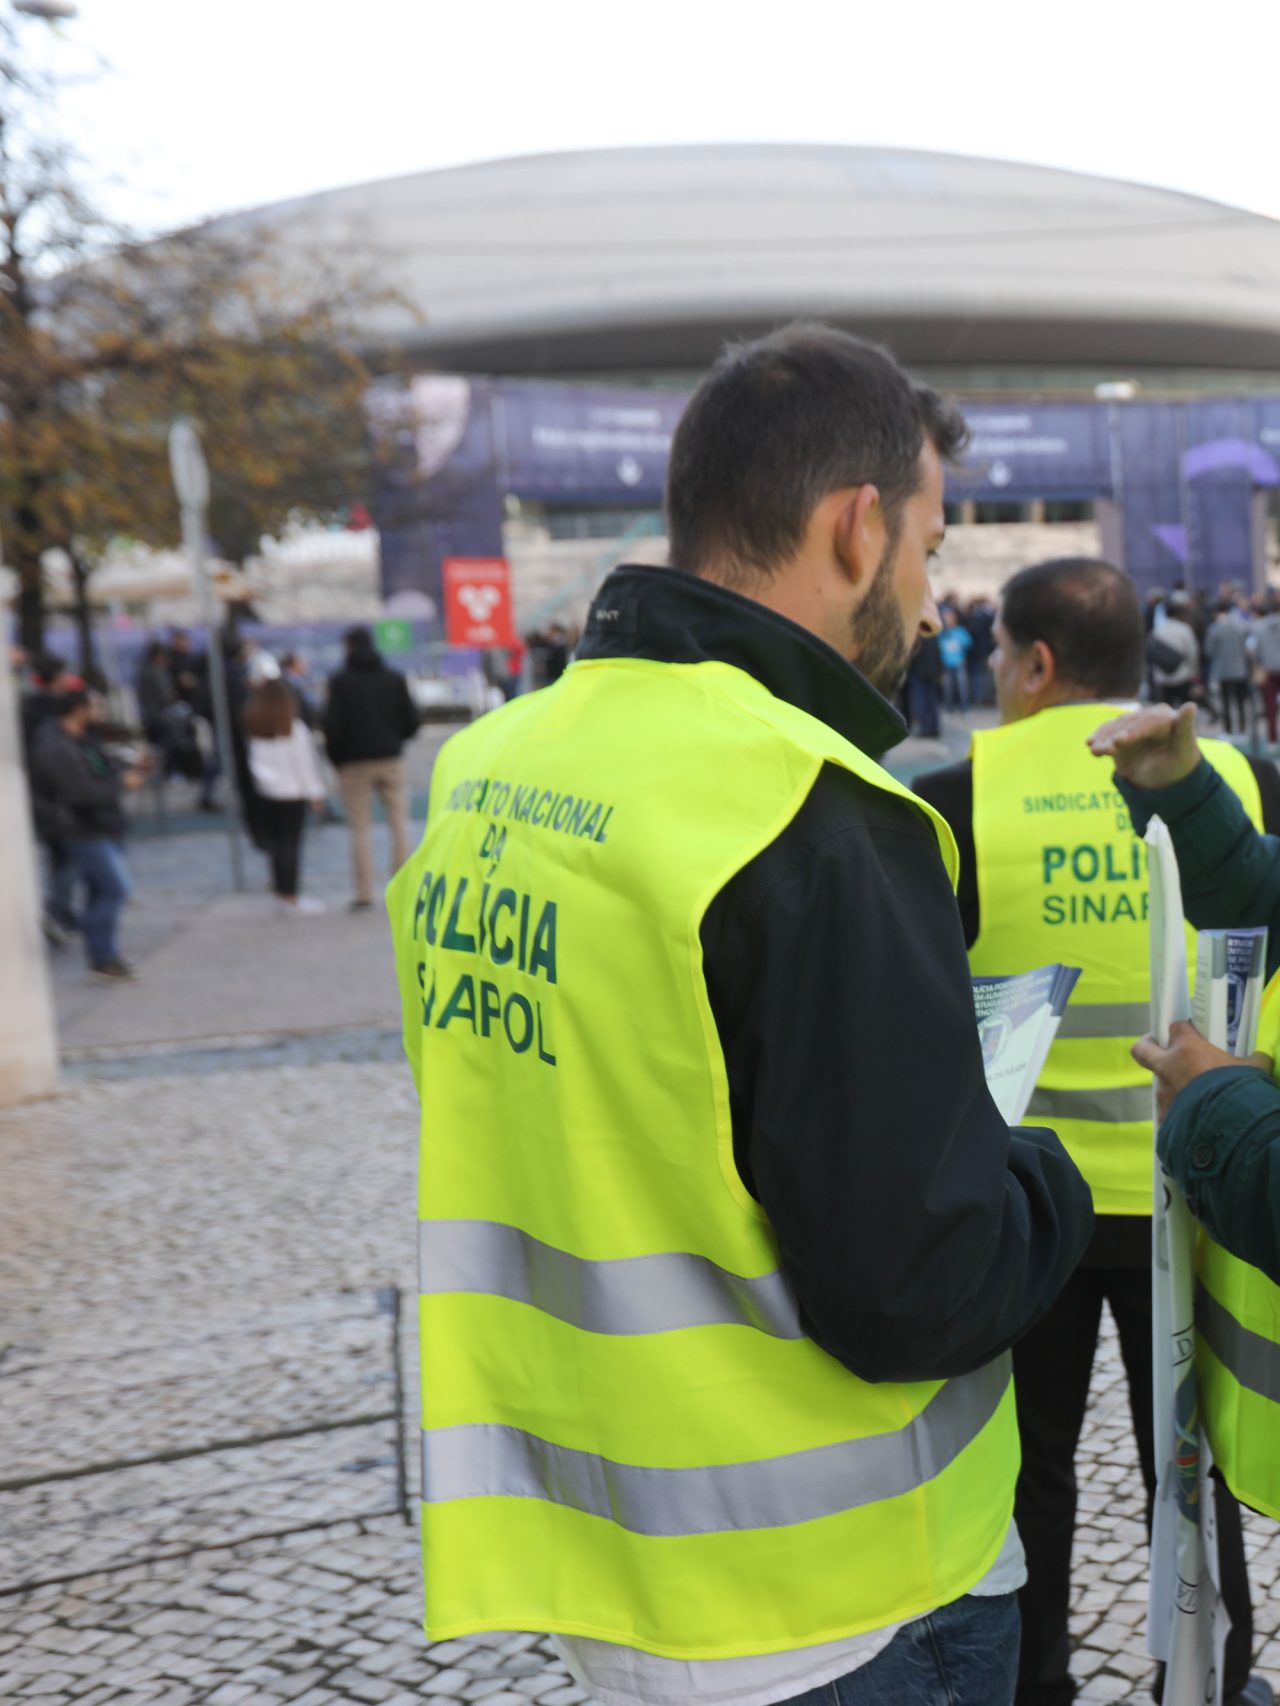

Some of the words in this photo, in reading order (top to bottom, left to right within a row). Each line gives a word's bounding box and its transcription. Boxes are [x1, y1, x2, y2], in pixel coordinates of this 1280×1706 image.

[507, 783, 614, 845] NACIONAL
[479, 822, 508, 862] DA
[1042, 836, 1149, 884] POLÍ
